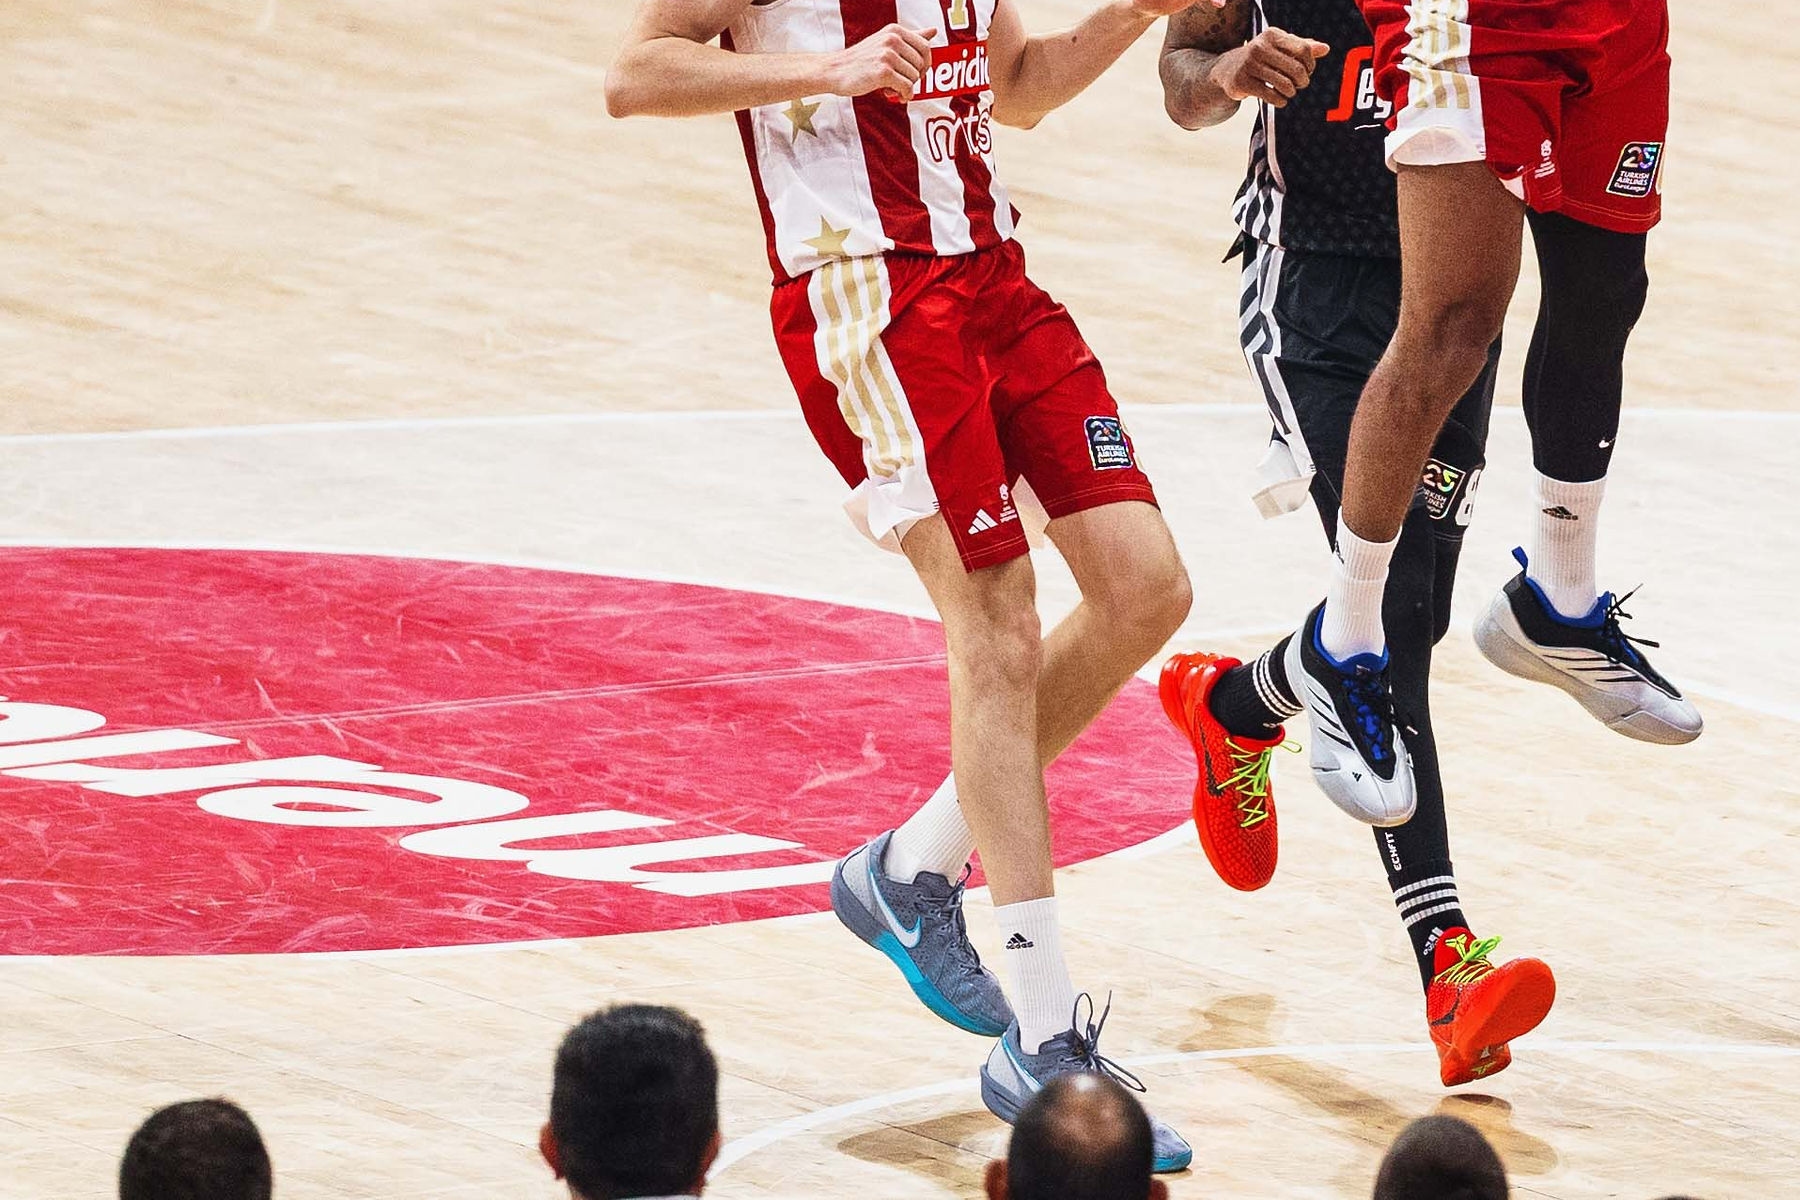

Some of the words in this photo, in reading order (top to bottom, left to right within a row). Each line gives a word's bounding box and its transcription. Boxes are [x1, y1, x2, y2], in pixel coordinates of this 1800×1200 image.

[926, 104, 993, 162] mts
[1622, 146, 1657, 169] 25
[1422, 463, 1459, 493] 25
